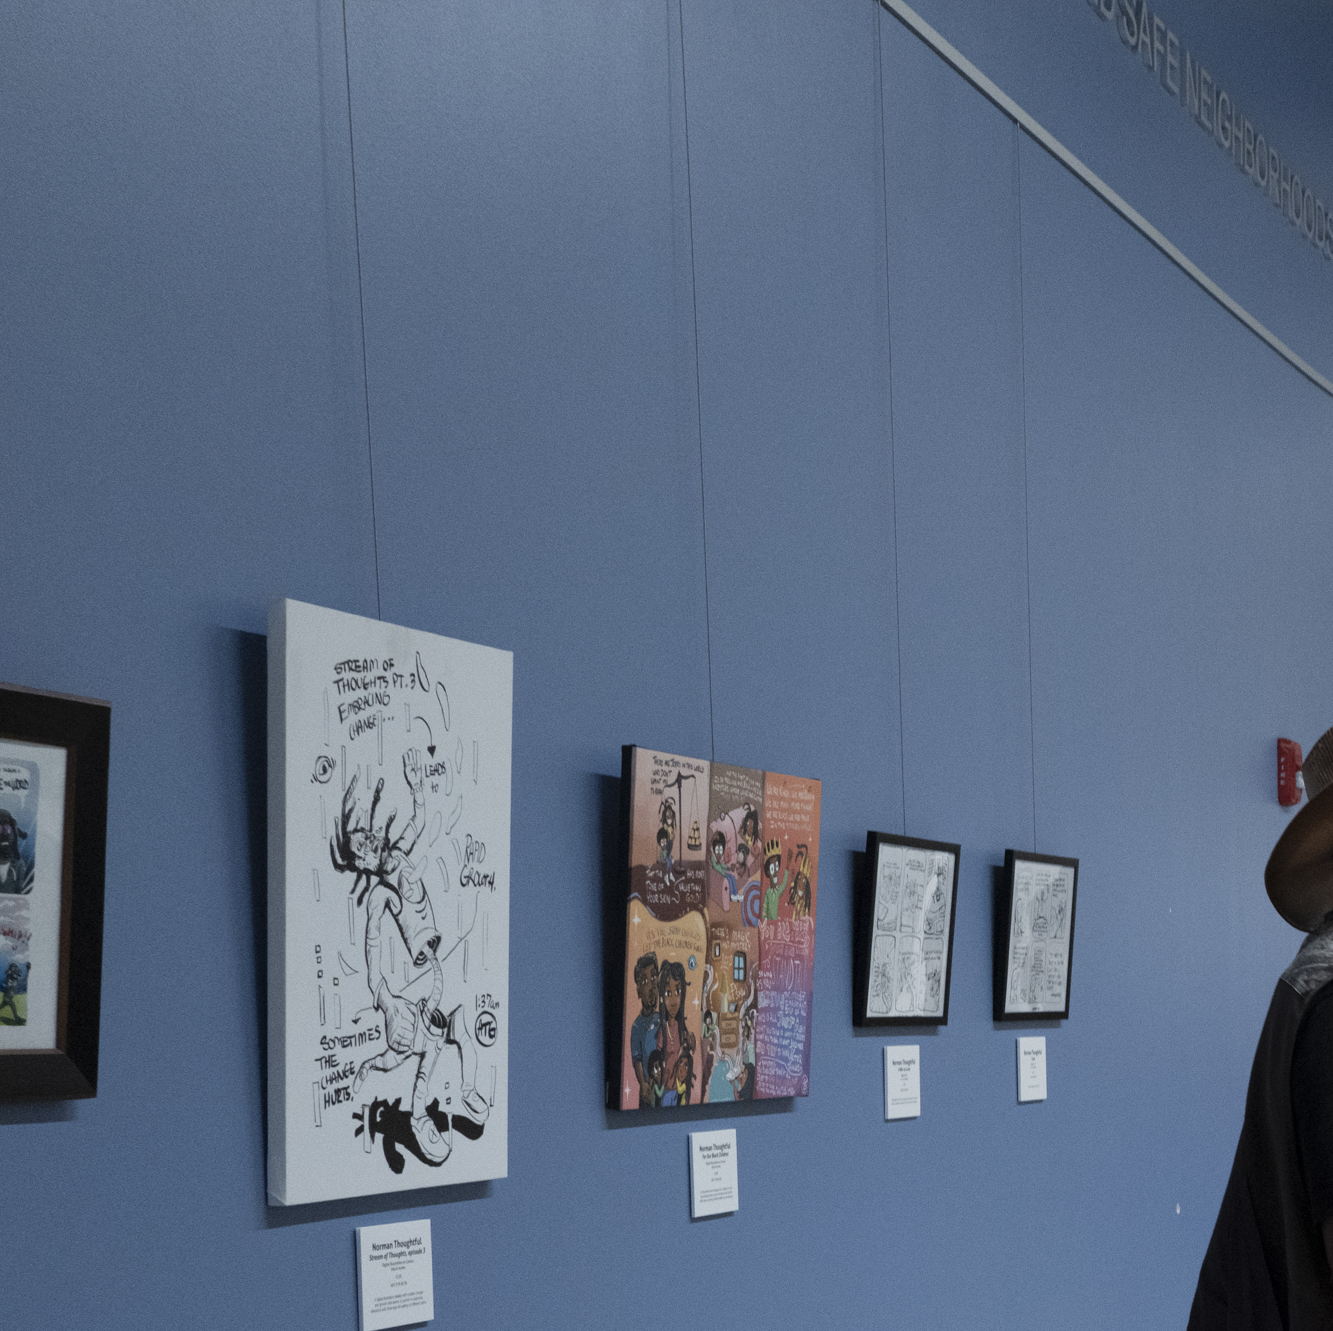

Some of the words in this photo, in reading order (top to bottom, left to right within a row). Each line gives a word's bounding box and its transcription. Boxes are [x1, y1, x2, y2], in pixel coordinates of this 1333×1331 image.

[1122, 0, 1180, 95] SAFE
[333, 658, 379, 675] STREAM
[382, 658, 394, 672] OF
[333, 675, 389, 696] THOUGHTS
[337, 690, 391, 725] EMBRACING
[424, 762, 446, 778] LEADS
[464, 833, 486, 865] RAPID
[320, 1024, 382, 1051] SOMETIMES
[314, 1053, 340, 1071] THE
[320, 1060, 356, 1090] CHANGE
[372, 1243, 393, 1251] Norman
[394, 1237, 422, 1250] Thoughtful
[369, 1254, 384, 1262] Stream
[384, 1252, 389, 1261] of
[408, 1248, 423, 1257] episode
